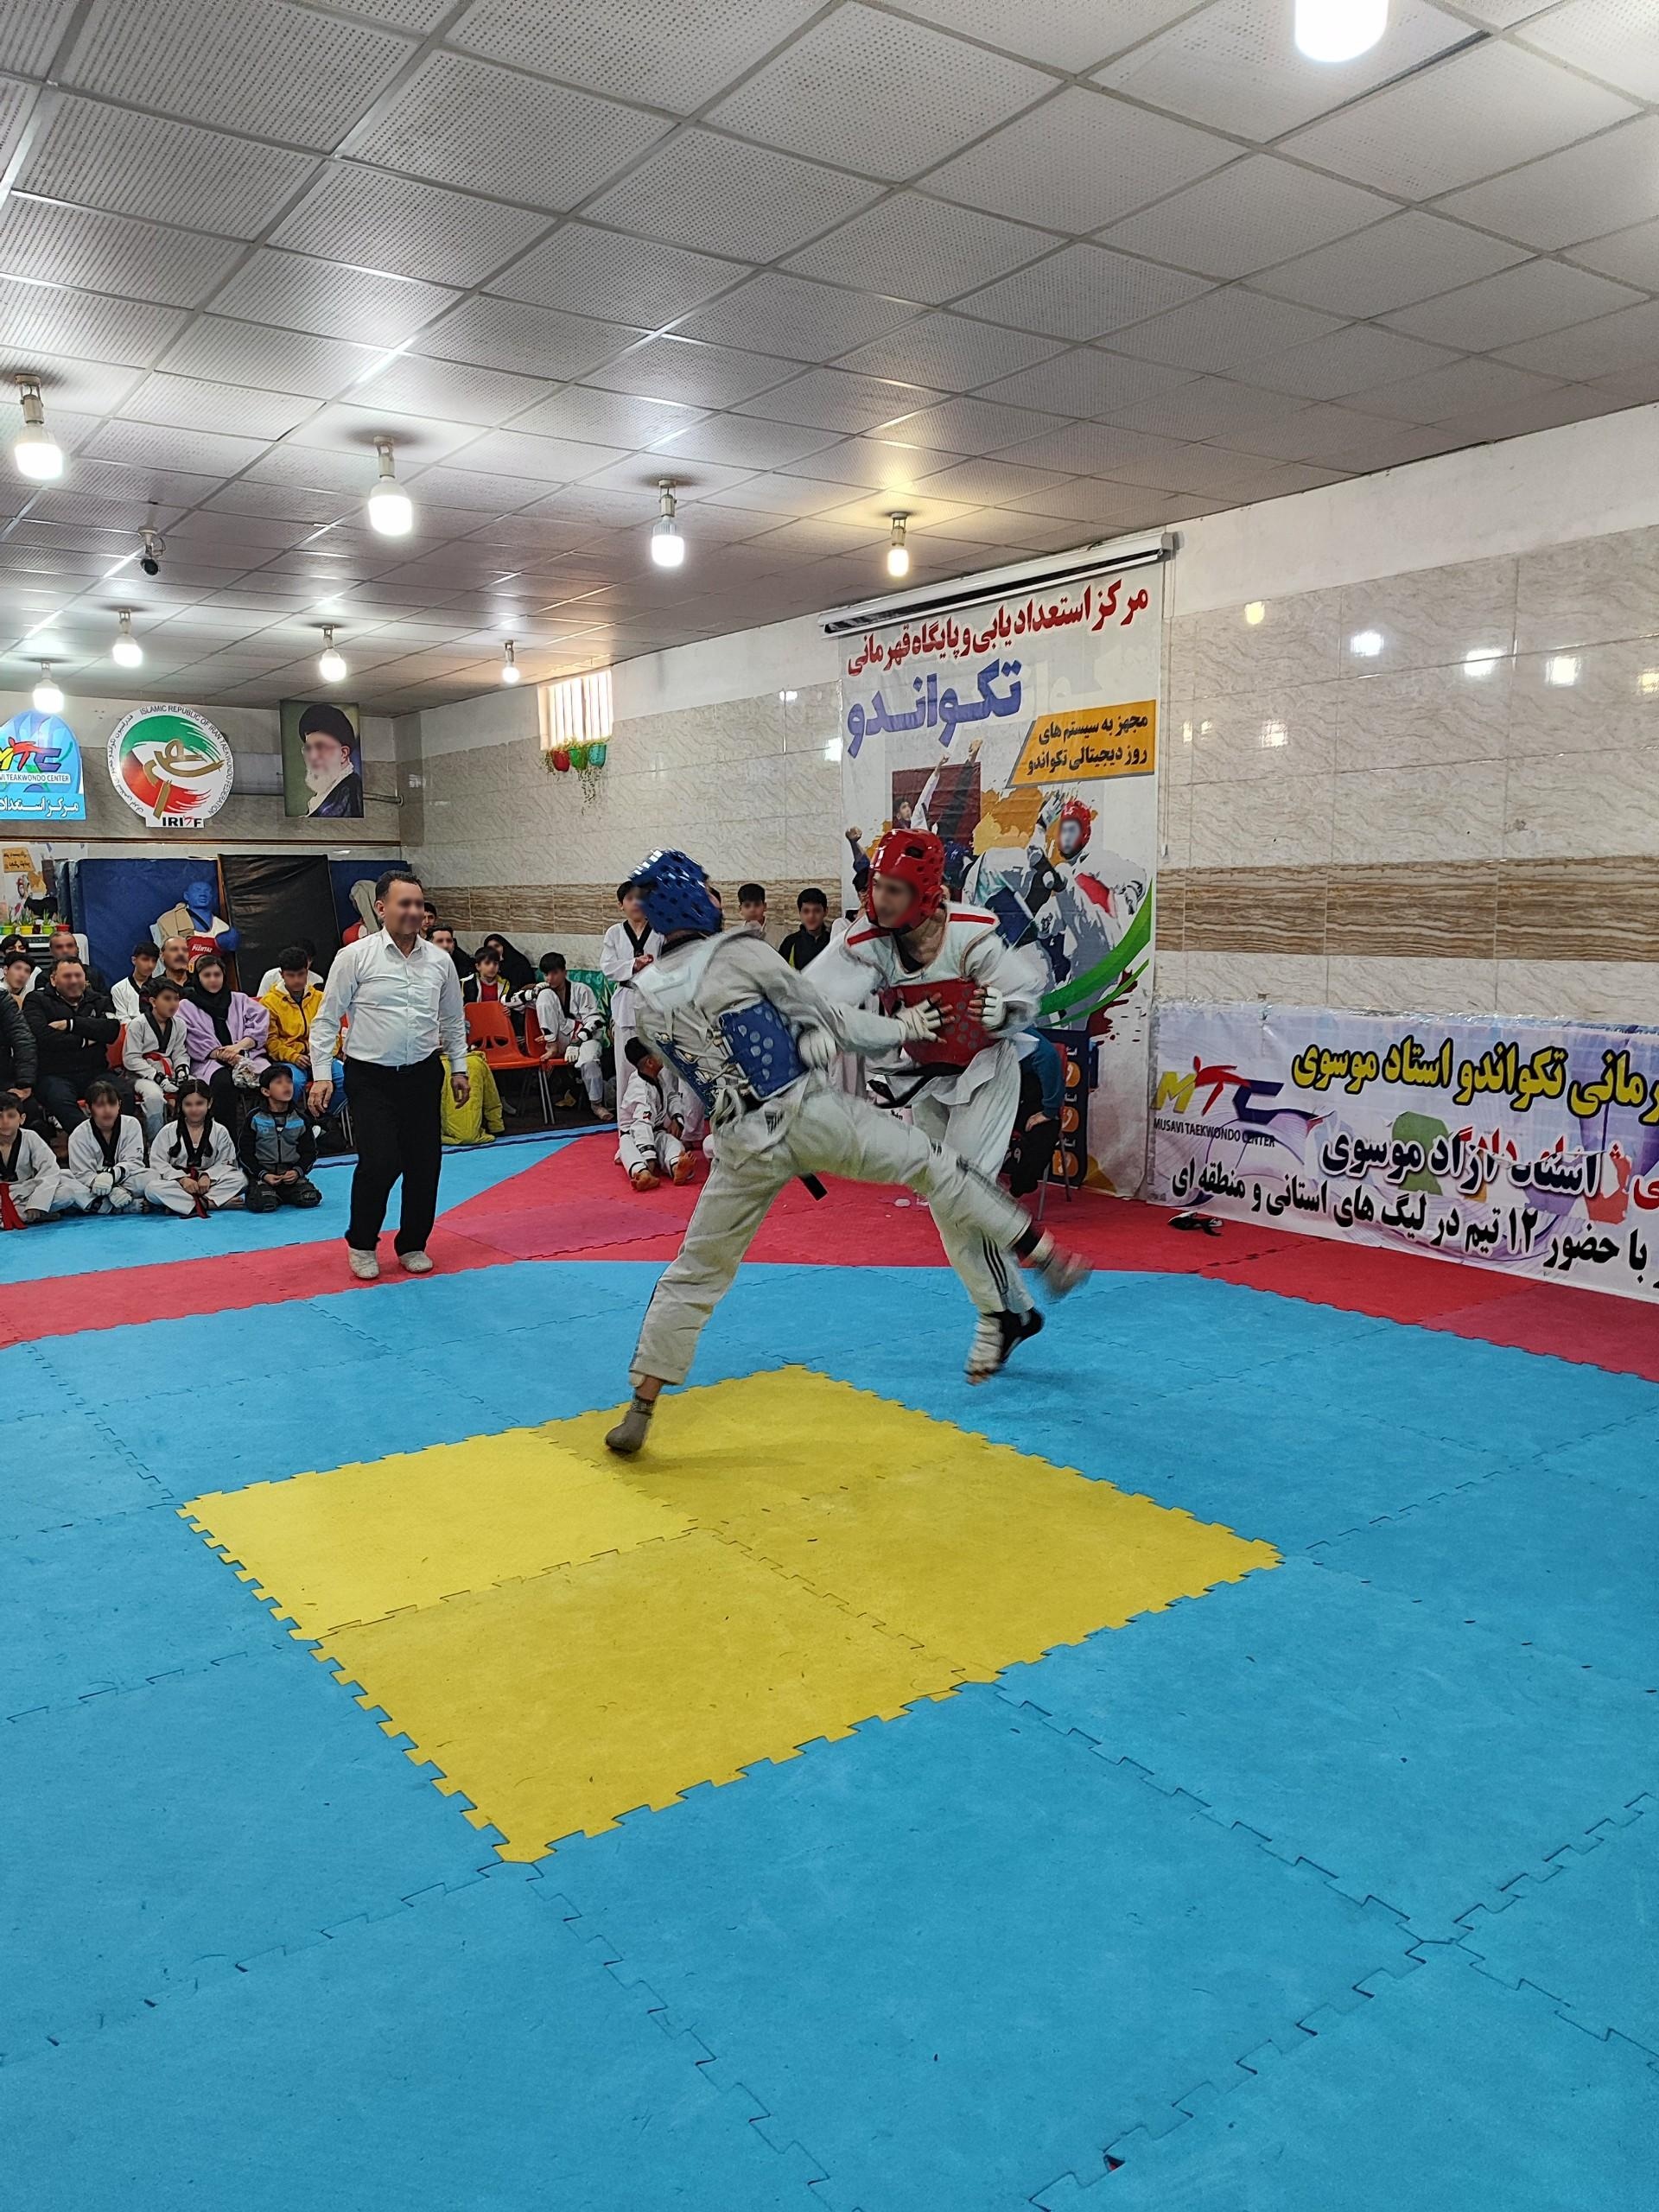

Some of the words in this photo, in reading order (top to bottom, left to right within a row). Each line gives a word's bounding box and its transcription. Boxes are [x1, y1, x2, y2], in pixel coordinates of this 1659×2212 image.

[1091, 579, 1148, 632] مرکز
[848, 625, 910, 676] قهرمانی
[912, 617, 959, 659] پایگاه
[960, 628, 971, 657] و
[140, 705, 167, 715] ISLAMIC
[168, 705, 200, 722] REPUBLIC
[200, 718, 210, 728] OF
[848, 658, 1022, 759] تکواندو
[1101, 717, 1113, 735] به
[1115, 714, 1148, 736] مجهز
[208, 724, 222, 741] IRAN
[1039, 722, 1061, 745] های
[1064, 721, 1099, 743] سیستم
[220, 737, 233, 779] TAEKWONDO
[1027, 748, 1068, 775] تکواندو
[1069, 745, 1122, 770] دیجیتالی
[1124, 745, 1147, 766] روز
[47, 773, 69, 782] CENTER
[46, 798, 79, 817] مرکز
[207, 779, 232, 815] FEDERATION
[1292, 1044, 1380, 1095] موسوی
[1382, 1034, 1453, 1089] استاد
[1452, 1041, 1568, 1112] تکواندو
[1151, 1056, 1285, 1126] MTC
[1154, 1118, 1184, 1132] MUSAVI
[1185, 1122, 1241, 1142] TAEKWONDO
[1242, 1131, 1275, 1147] CENTER
[1322, 1133, 1421, 1180] موسوی
[1172, 1156, 1195, 1198] ای
[1198, 1161, 1246, 1199] منطقه
[1266, 1173, 1328, 1217] استانی
[1251, 1183, 1262, 1212] و
[1333, 1185, 1375, 1228] های
[1382, 1194, 1427, 1238] لیگ
[1430, 1208, 1460, 1246] در
[1465, 1209, 1499, 1253] تیم
[1510, 1207, 1538, 1253] ۱۲
[1542, 1223, 1621, 1271] حضور
[1629, 1228, 1647, 1284] با
